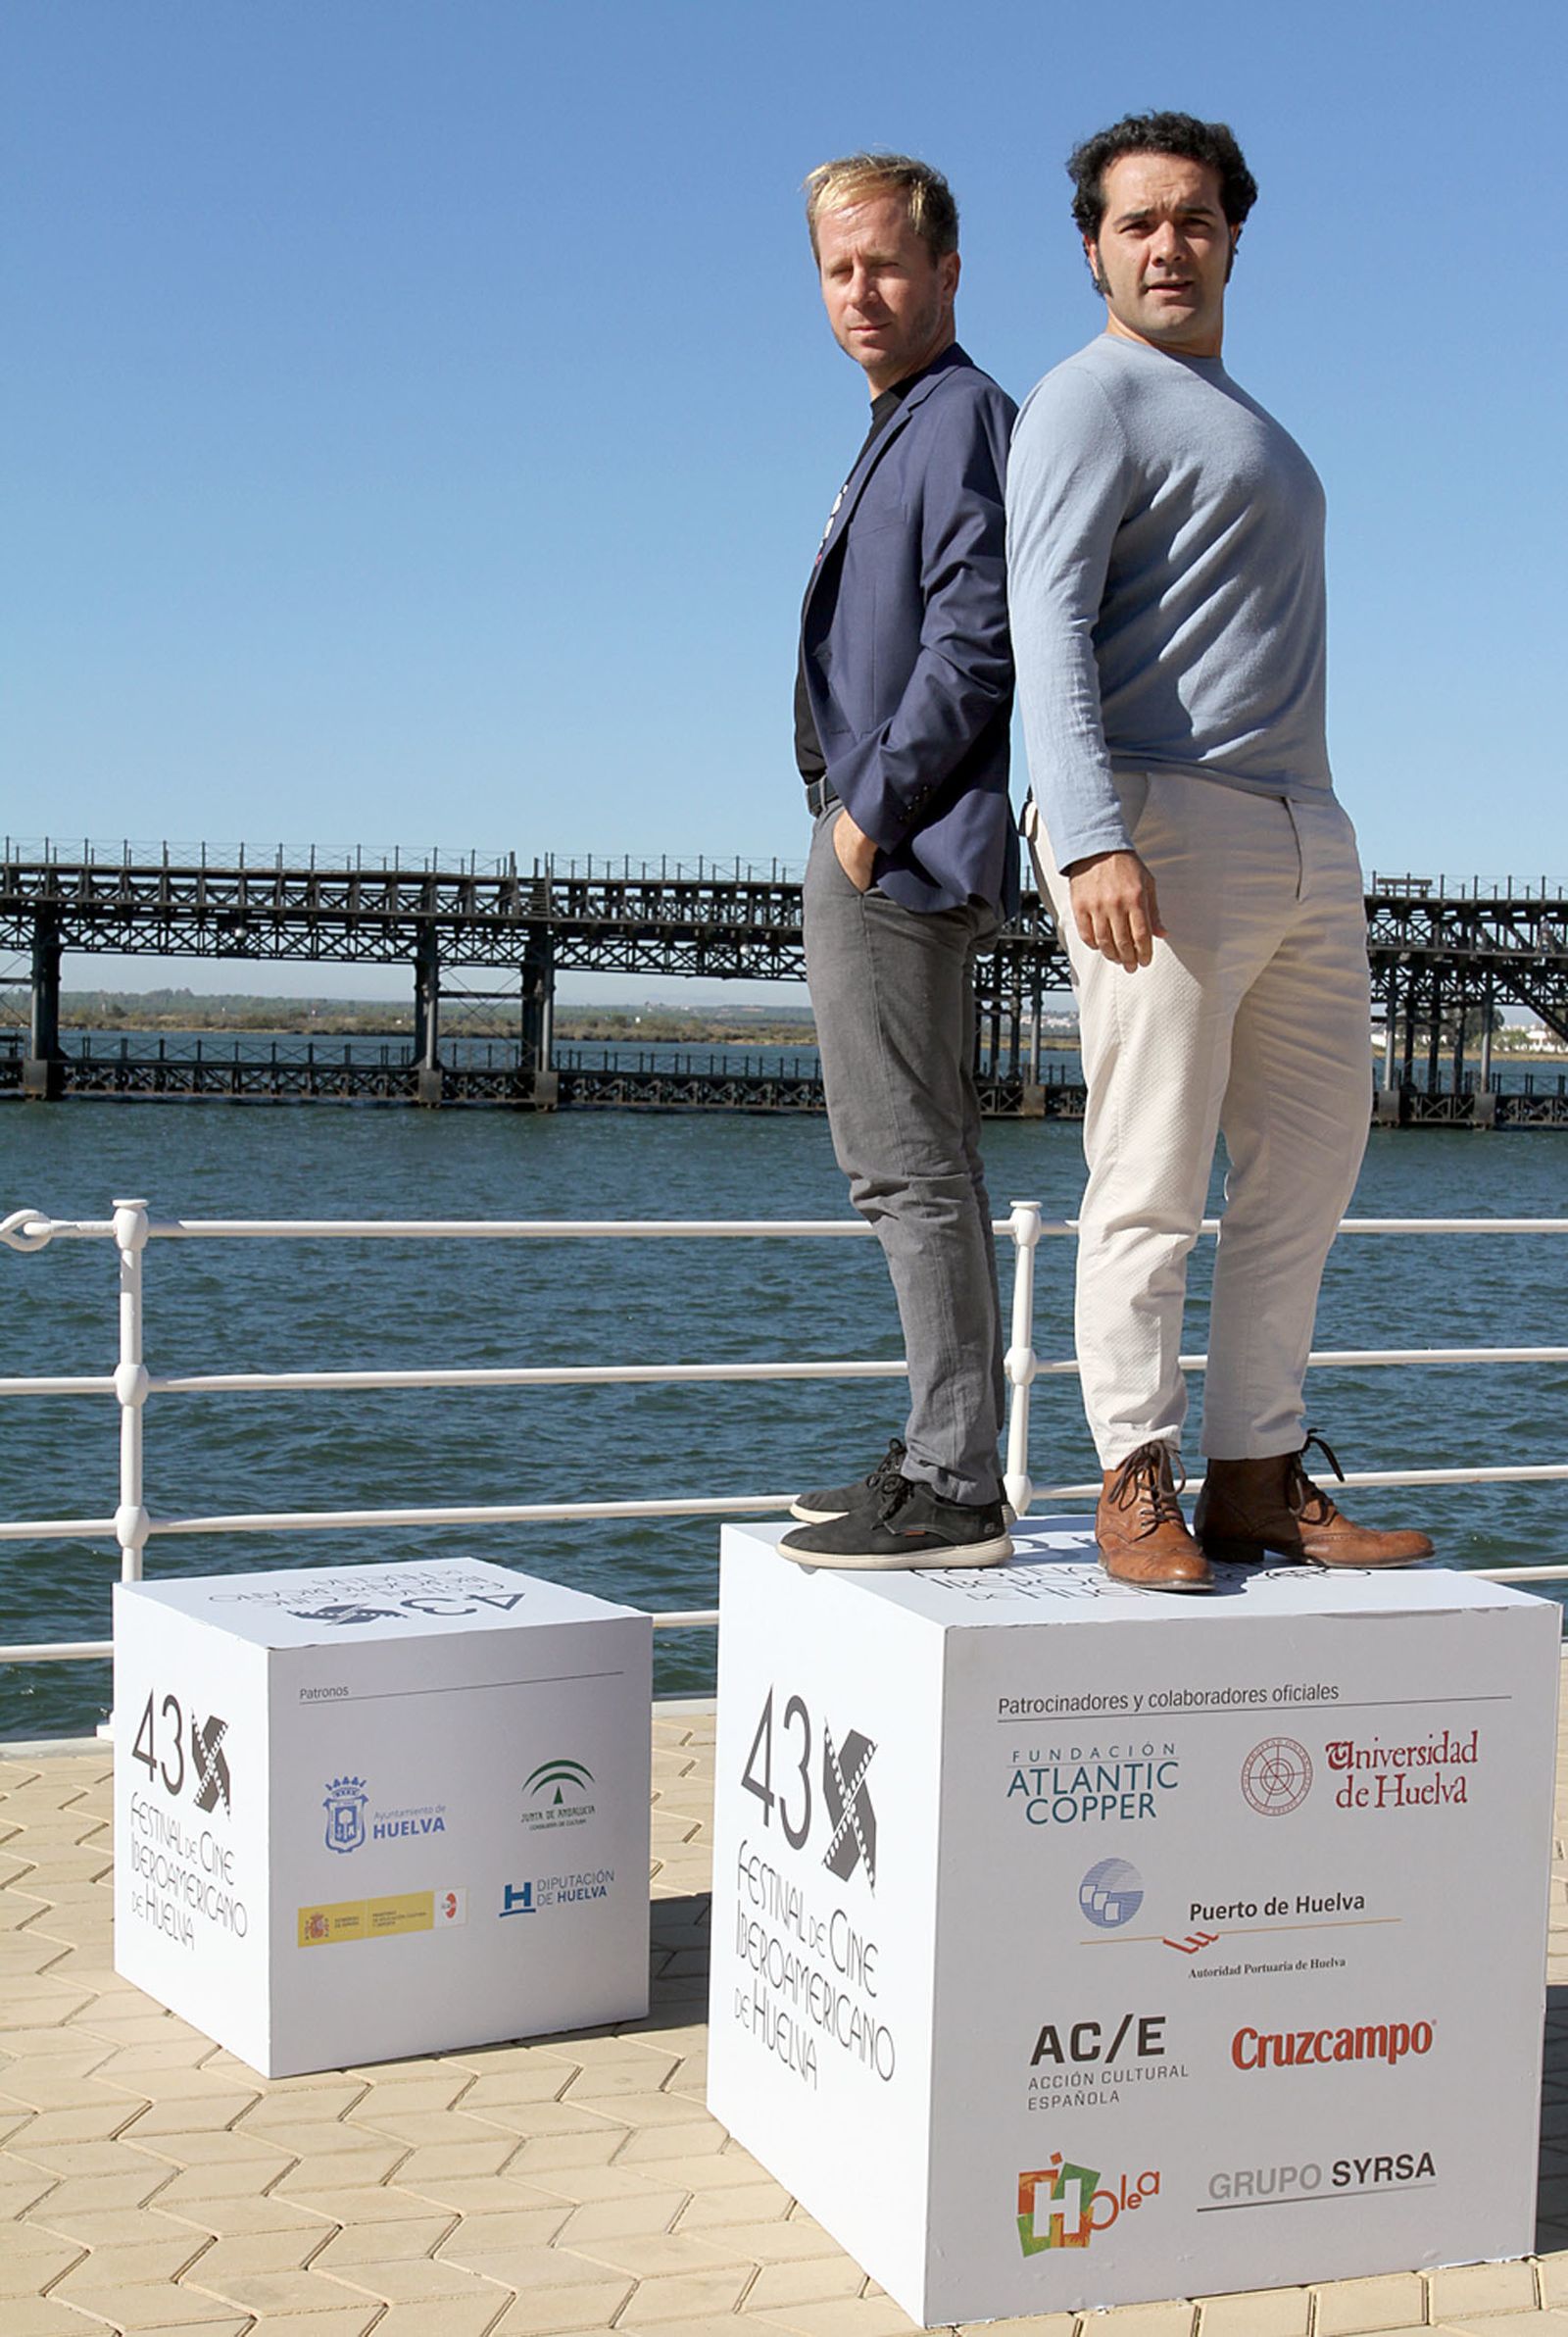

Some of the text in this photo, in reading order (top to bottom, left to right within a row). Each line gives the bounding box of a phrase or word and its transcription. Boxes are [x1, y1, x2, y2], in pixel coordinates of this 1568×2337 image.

[299, 1686, 349, 1700] Patronos
[999, 1683, 1339, 1715] Patrocinadores y colaboradores oficiales
[131, 1687, 185, 1796] 43
[1012, 1740, 1176, 1763] FUNDACIÓN
[1326, 1729, 1479, 1769] Universidad
[741, 1682, 811, 1850] 43
[1007, 1762, 1179, 1797] ATLANTIC
[1336, 1774, 1368, 1808] de
[1374, 1771, 1468, 1808] Huelva
[374, 1805, 446, 1820] Ayuntamiento de
[1026, 1793, 1156, 1824] COPPER
[130, 1791, 183, 1857] FESTIVAL
[200, 1830, 234, 1885] CINE
[373, 1816, 446, 1839] HUELVA
[130, 1831, 247, 1938] IBEROAMERICANO
[537, 1868, 614, 1892] DIPUTACIÓN
[537, 1885, 608, 1907] DE HUELVA
[145, 1883, 194, 1951] HUELVA
[737, 1839, 878, 1998] FESTIVAL DE CINE
[1190, 1892, 1365, 1921] Puerto de Huelva
[1188, 1957, 1346, 1979] Autoridad Portuaria de Huelva
[736, 1899, 895, 2081] IBEROAMERICANO
[753, 1978, 817, 2090] HUELVA
[1030, 2013, 1166, 2065] AC/E
[1232, 2020, 1433, 2070] Cruzcampo
[1028, 2064, 1189, 2091] ACCIÓN CULTURAL
[1028, 2090, 1120, 2111] ESPAÑOLA
[1209, 2152, 1437, 2200] GRUPO SYRSA
